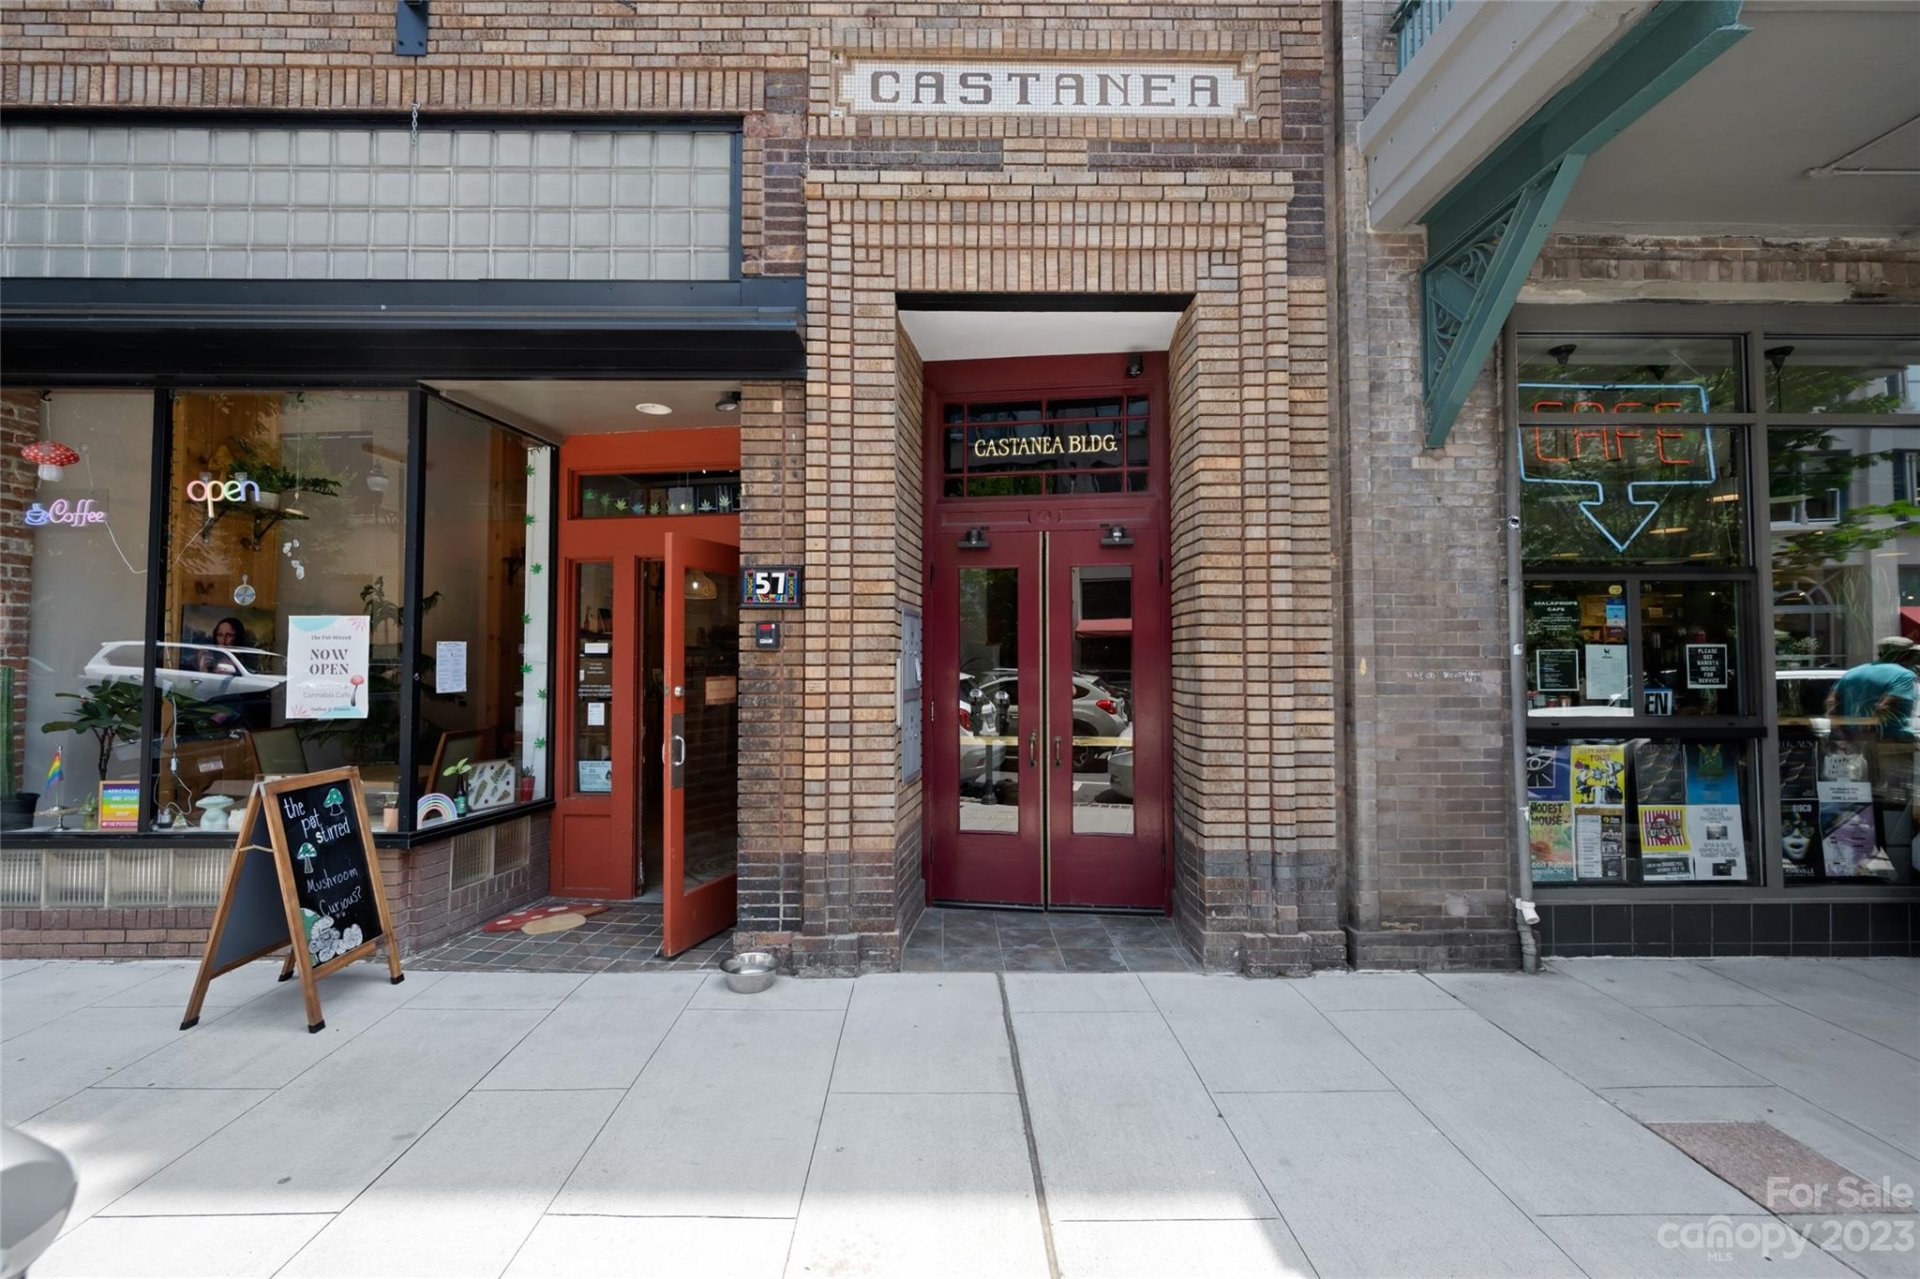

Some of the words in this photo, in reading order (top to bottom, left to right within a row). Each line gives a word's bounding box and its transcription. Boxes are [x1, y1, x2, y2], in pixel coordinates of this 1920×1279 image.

[870, 70, 1222, 108] CASTANEA
[974, 436, 1065, 457] CASTANEA
[1068, 434, 1118, 454] BLDG.
[1533, 401, 1694, 464] CAFE
[49, 498, 105, 527] Coffee
[186, 479, 260, 519] open
[755, 572, 786, 594] 57
[310, 648, 348, 660] NOW
[309, 663, 350, 675] OPEN
[284, 798, 306, 819] the
[1530, 803, 1563, 814] MODEST
[1531, 815, 1562, 825] MOUSE
[301, 808, 322, 838] pot
[315, 817, 351, 844] stirred
[306, 867, 359, 894] Mushroom
[318, 886, 363, 916] Curious?
